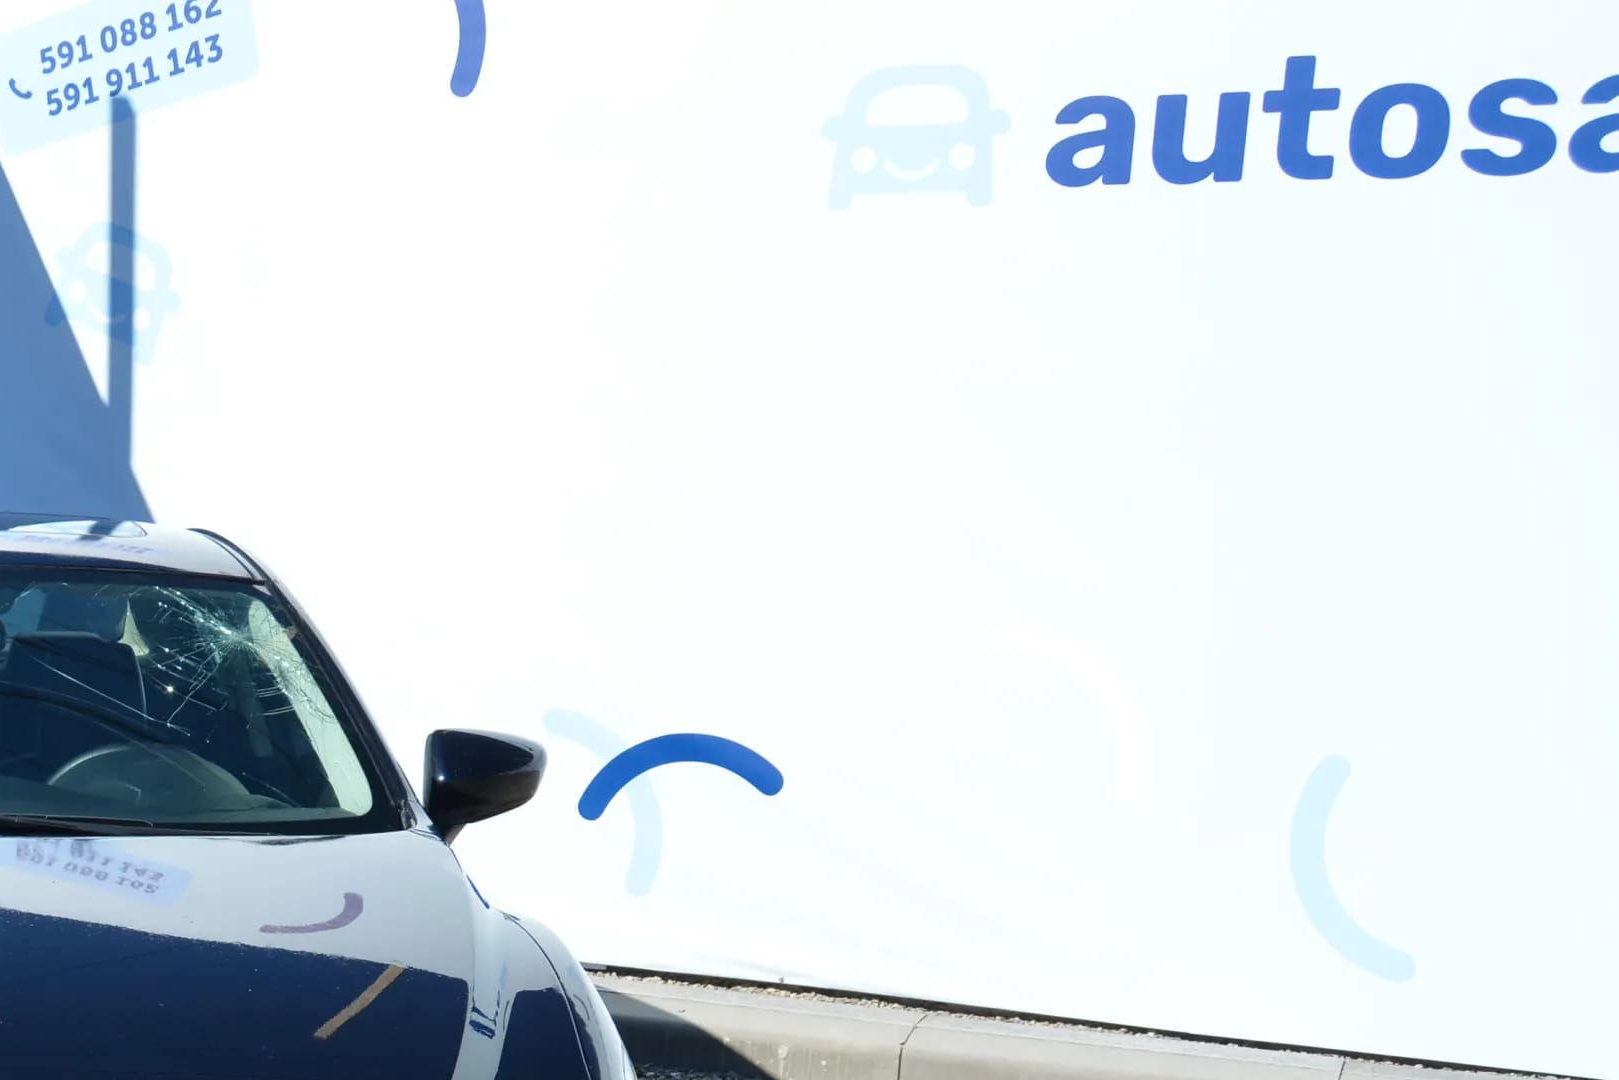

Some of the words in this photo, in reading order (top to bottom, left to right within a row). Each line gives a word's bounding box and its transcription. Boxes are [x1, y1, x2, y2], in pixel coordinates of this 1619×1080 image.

[40, 34, 93, 74] 591
[100, 11, 157, 53] 088
[165, 0, 222, 32] 162
[46, 77, 100, 116] 591
[105, 56, 160, 97] 911
[167, 33, 223, 77] 143
